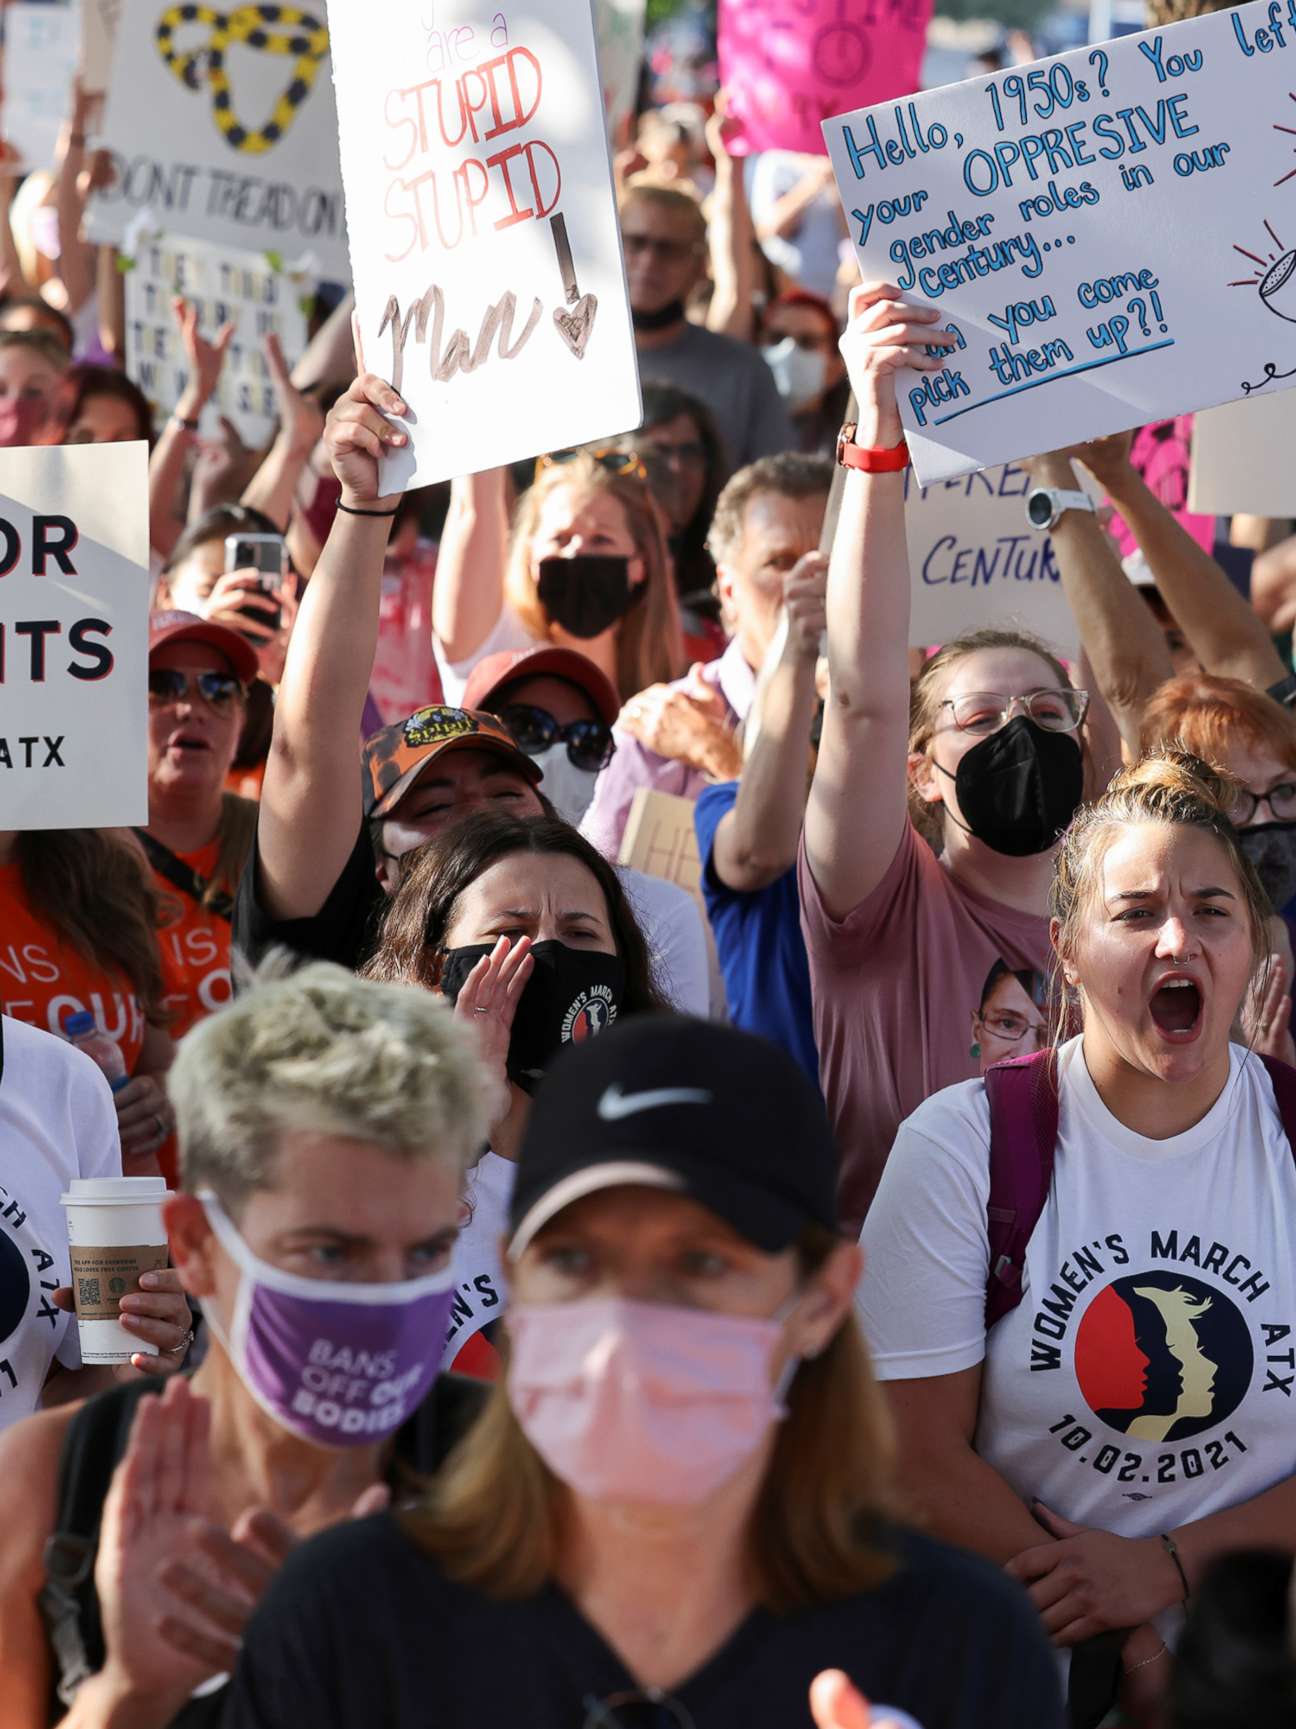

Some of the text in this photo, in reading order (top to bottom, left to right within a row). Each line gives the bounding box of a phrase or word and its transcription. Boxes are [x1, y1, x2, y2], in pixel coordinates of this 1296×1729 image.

[426, 13, 508, 74] are a
[384, 47, 542, 171] STUPID
[842, 104, 965, 179] Hello,
[985, 49, 1111, 131] 1950s?
[1138, 35, 1205, 83] You
[384, 140, 561, 262] STUPID
[851, 93, 1200, 246] your OPPRESIVE
[889, 139, 1233, 291] gender roles in our
[922, 231, 1077, 299] century...
[987, 295, 1057, 346] you
[1077, 268, 1159, 309] come
[908, 290, 1168, 427] pick them up?!
[922, 533, 1062, 588] CENTUR
[309, 1337, 396, 1379] BANS
[1030, 1230, 1296, 1397] WOMEN'S MARCH ATX
[302, 1365, 370, 1403] OFF
[1047, 1413, 1248, 1484] 10.02.2021
